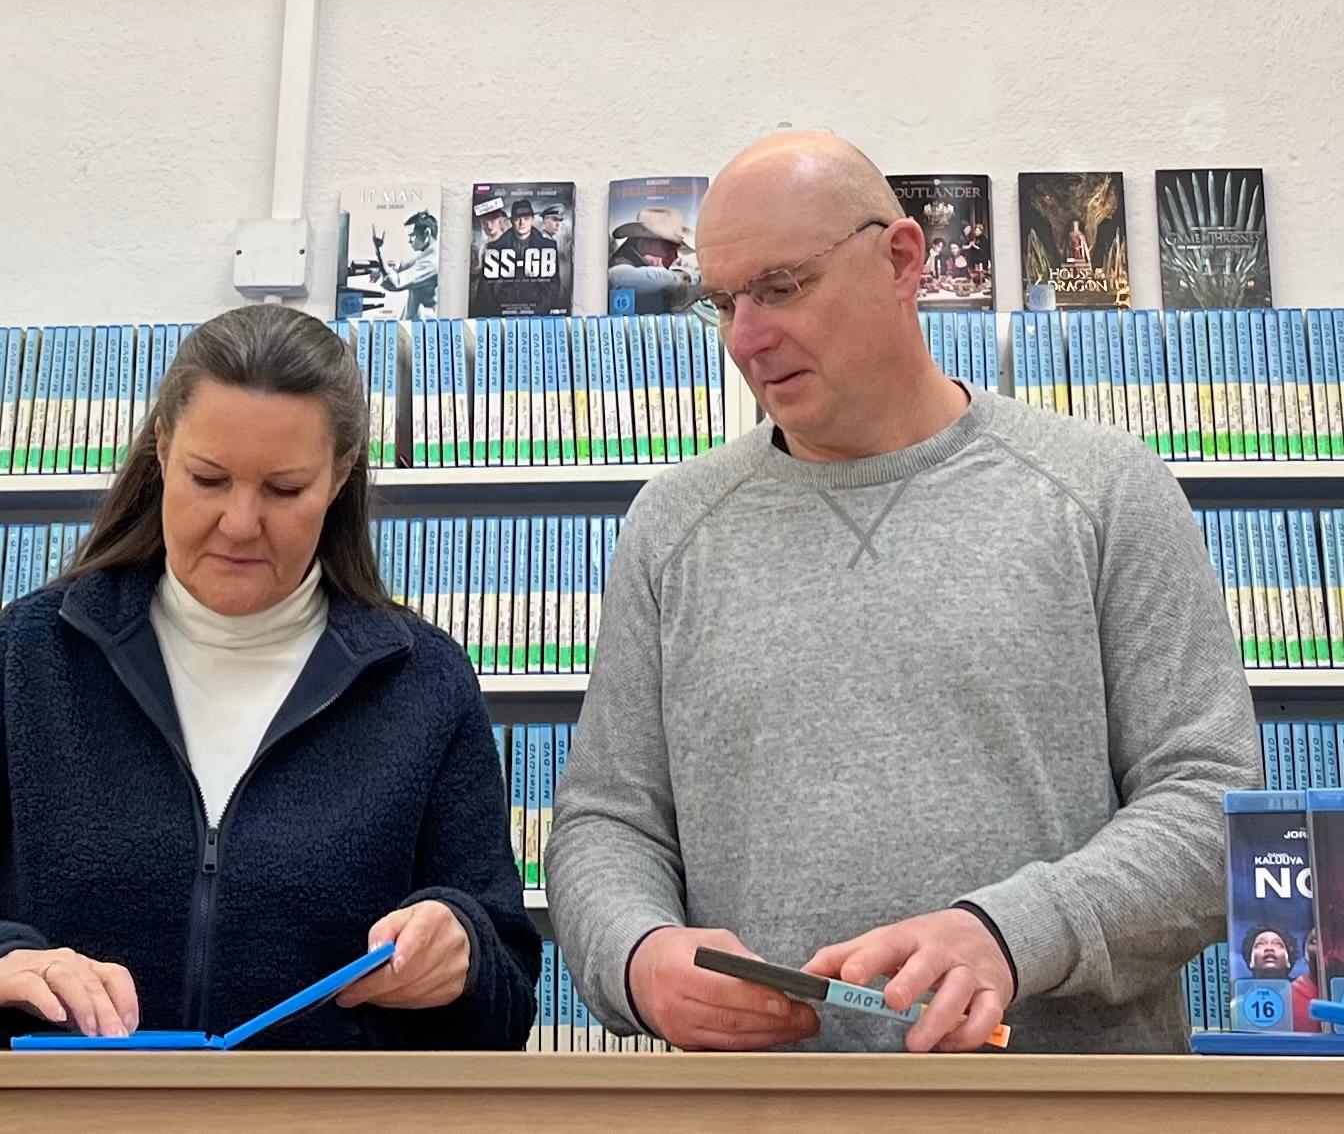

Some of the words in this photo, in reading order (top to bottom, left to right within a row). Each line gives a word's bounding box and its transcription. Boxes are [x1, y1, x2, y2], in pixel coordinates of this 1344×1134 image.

[382, 188, 423, 203] MAN
[894, 187, 981, 199] OUTLANDER
[483, 248, 557, 279] SS-GB
[1049, 268, 1091, 280] HOUSE
[1047, 279, 1108, 292] DRAGON
[1254, 856, 1304, 865] KALUUYA
[1251, 1001, 1275, 1018] 16
